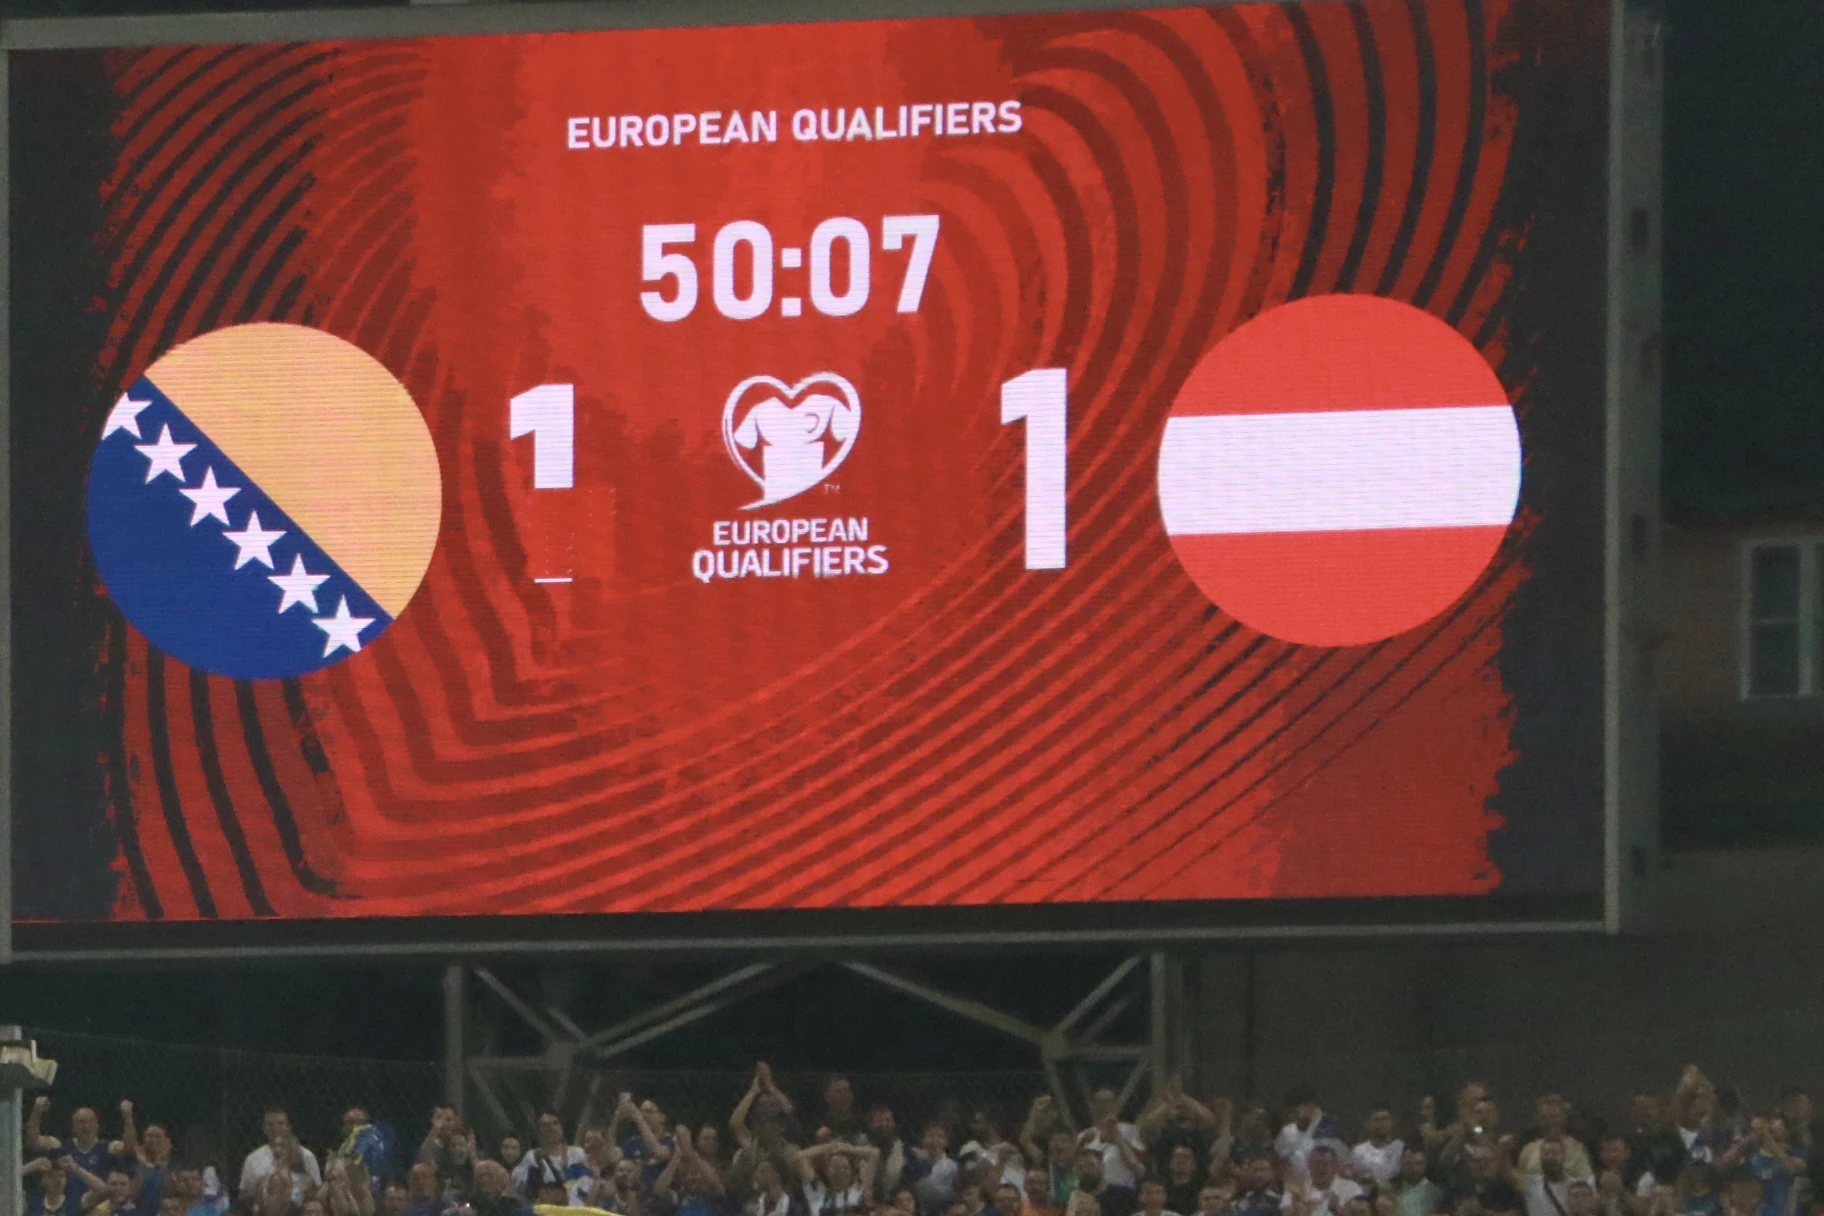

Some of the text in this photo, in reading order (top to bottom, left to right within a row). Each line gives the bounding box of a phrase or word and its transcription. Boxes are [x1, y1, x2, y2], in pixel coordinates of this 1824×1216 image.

[567, 100, 1023, 150] EUROPEAN QUALIFIERS
[639, 213, 941, 323] 50:07
[509, 383, 574, 489] 1
[1000, 367, 1068, 570] 1
[691, 544, 890, 582] QUALIFIERS
[712, 516, 869, 546] EUROPEAN
